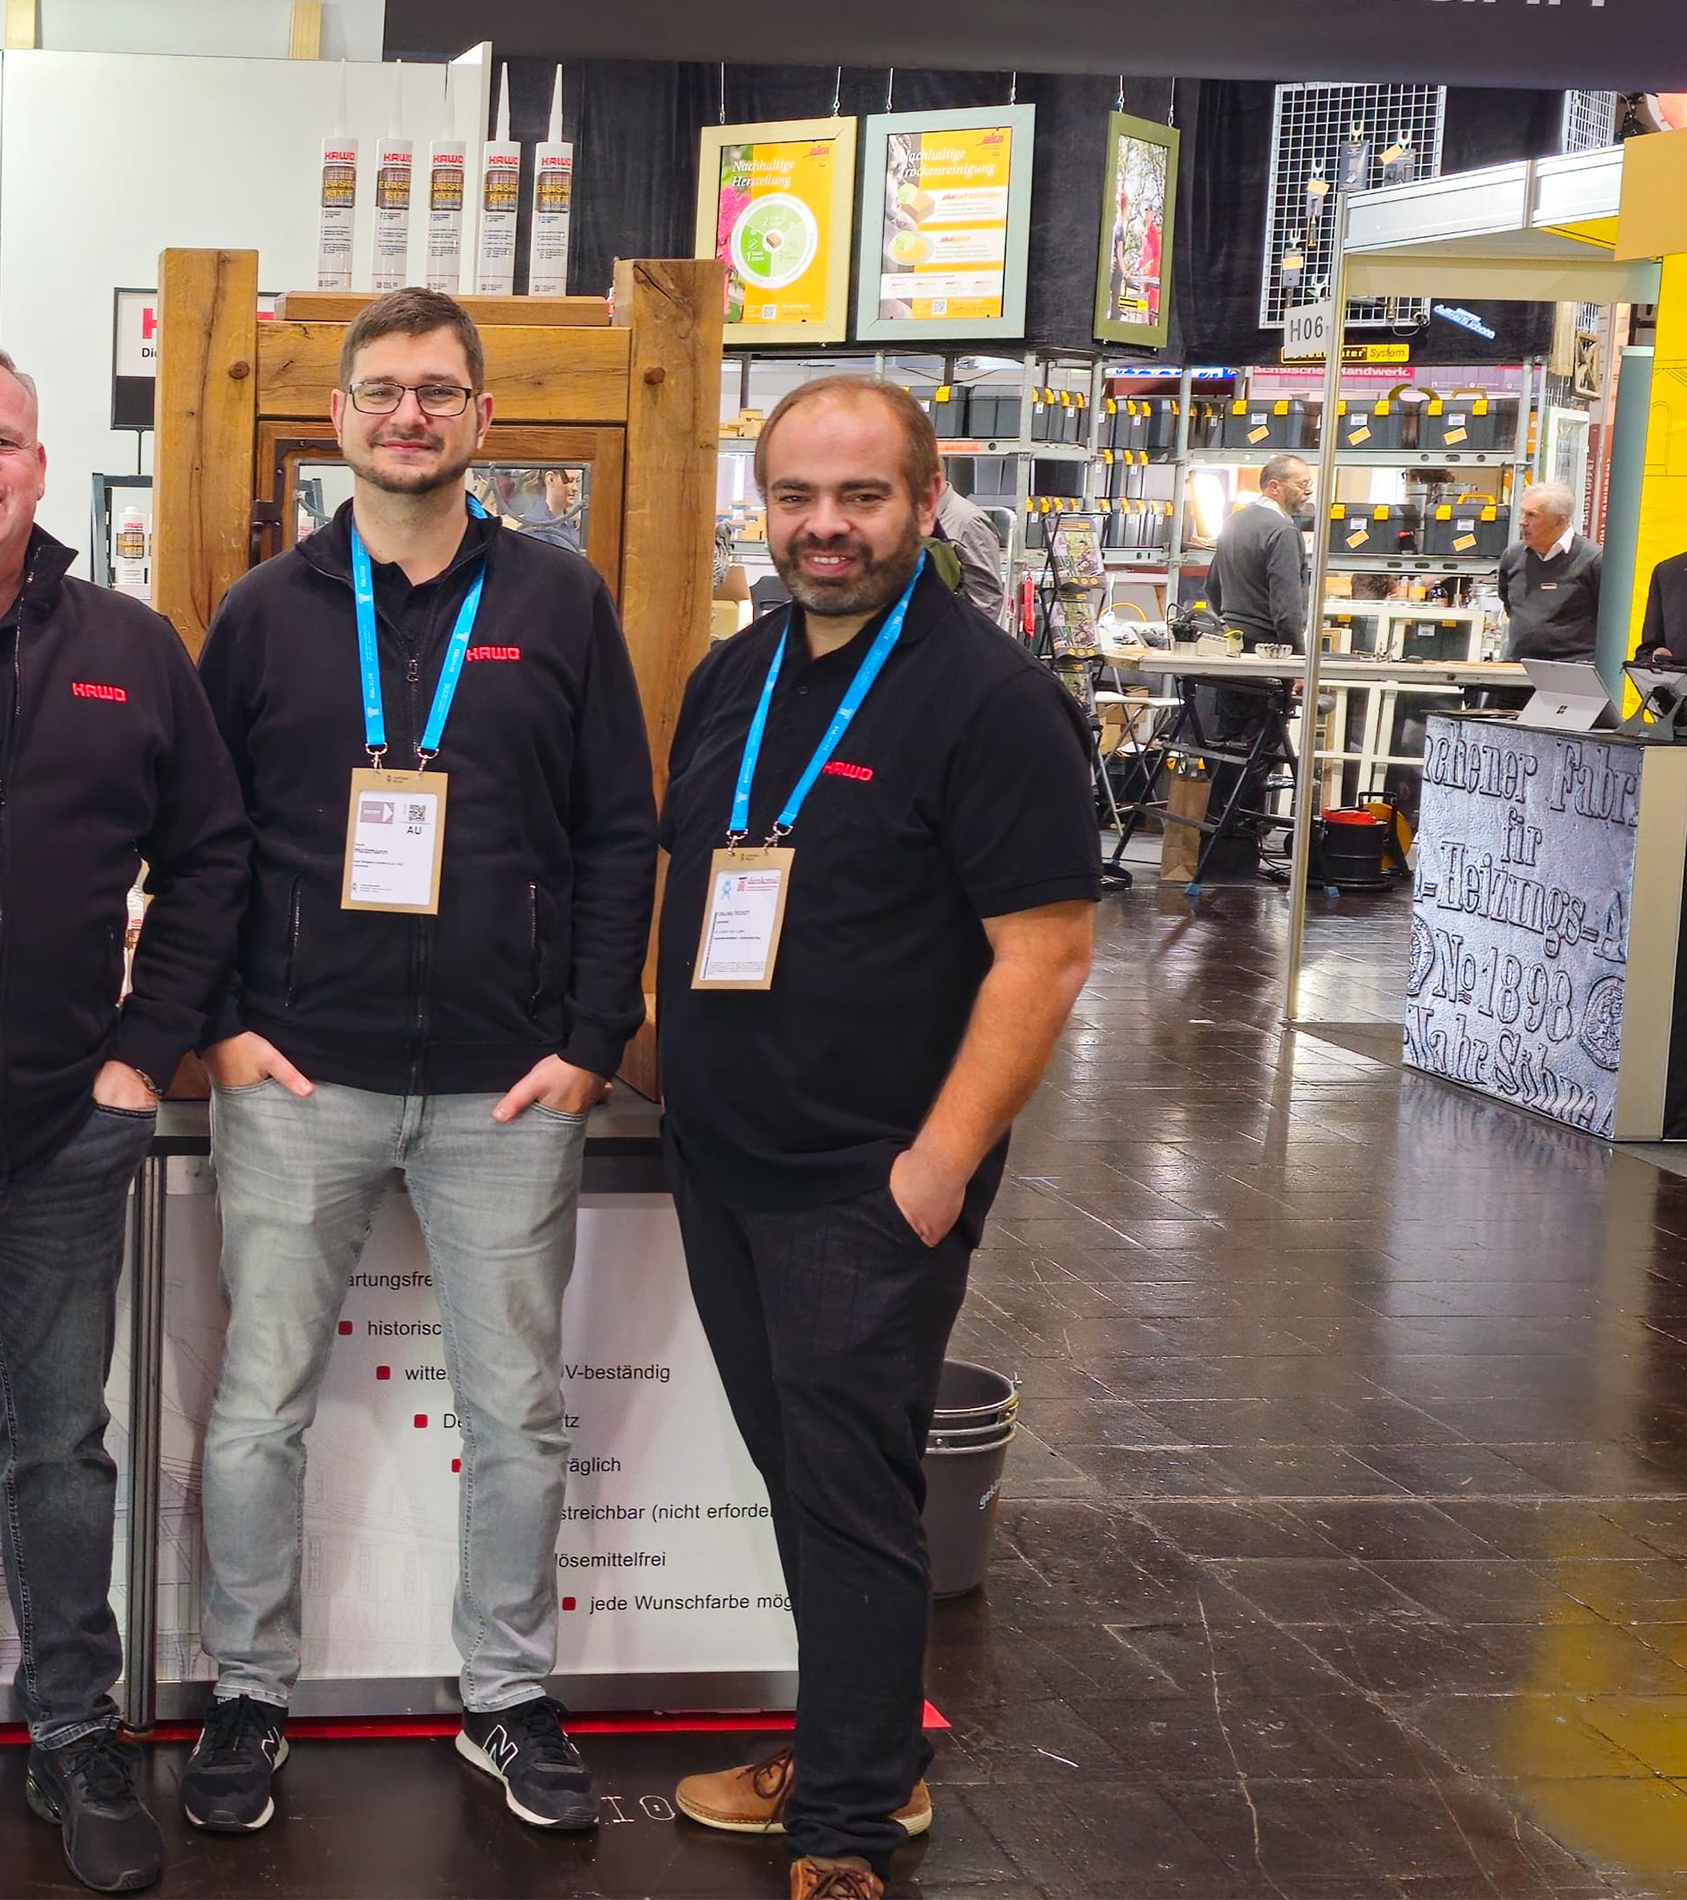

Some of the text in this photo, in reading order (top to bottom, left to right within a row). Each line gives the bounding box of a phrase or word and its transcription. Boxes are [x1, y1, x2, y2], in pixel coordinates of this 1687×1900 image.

[732, 159, 796, 173] Nachhaltige
[731, 175, 792, 189] Herstellung
[1290, 316, 1323, 343] H06
[466, 646, 521, 662] KAWO
[72, 682, 127, 702] KAWO
[821, 760, 875, 783] KAWO
[406, 825, 422, 835] AU
[348, 1271, 433, 1291] artungsfre
[368, 1320, 442, 1336] historisc
[405, 1365, 450, 1381] witte
[561, 1364, 671, 1383] V-beständig
[567, 1457, 621, 1476] äglich
[561, 1503, 773, 1523] streichbar (nicht erforde
[589, 1594, 793, 1615] jede Wunschfarbe mög
